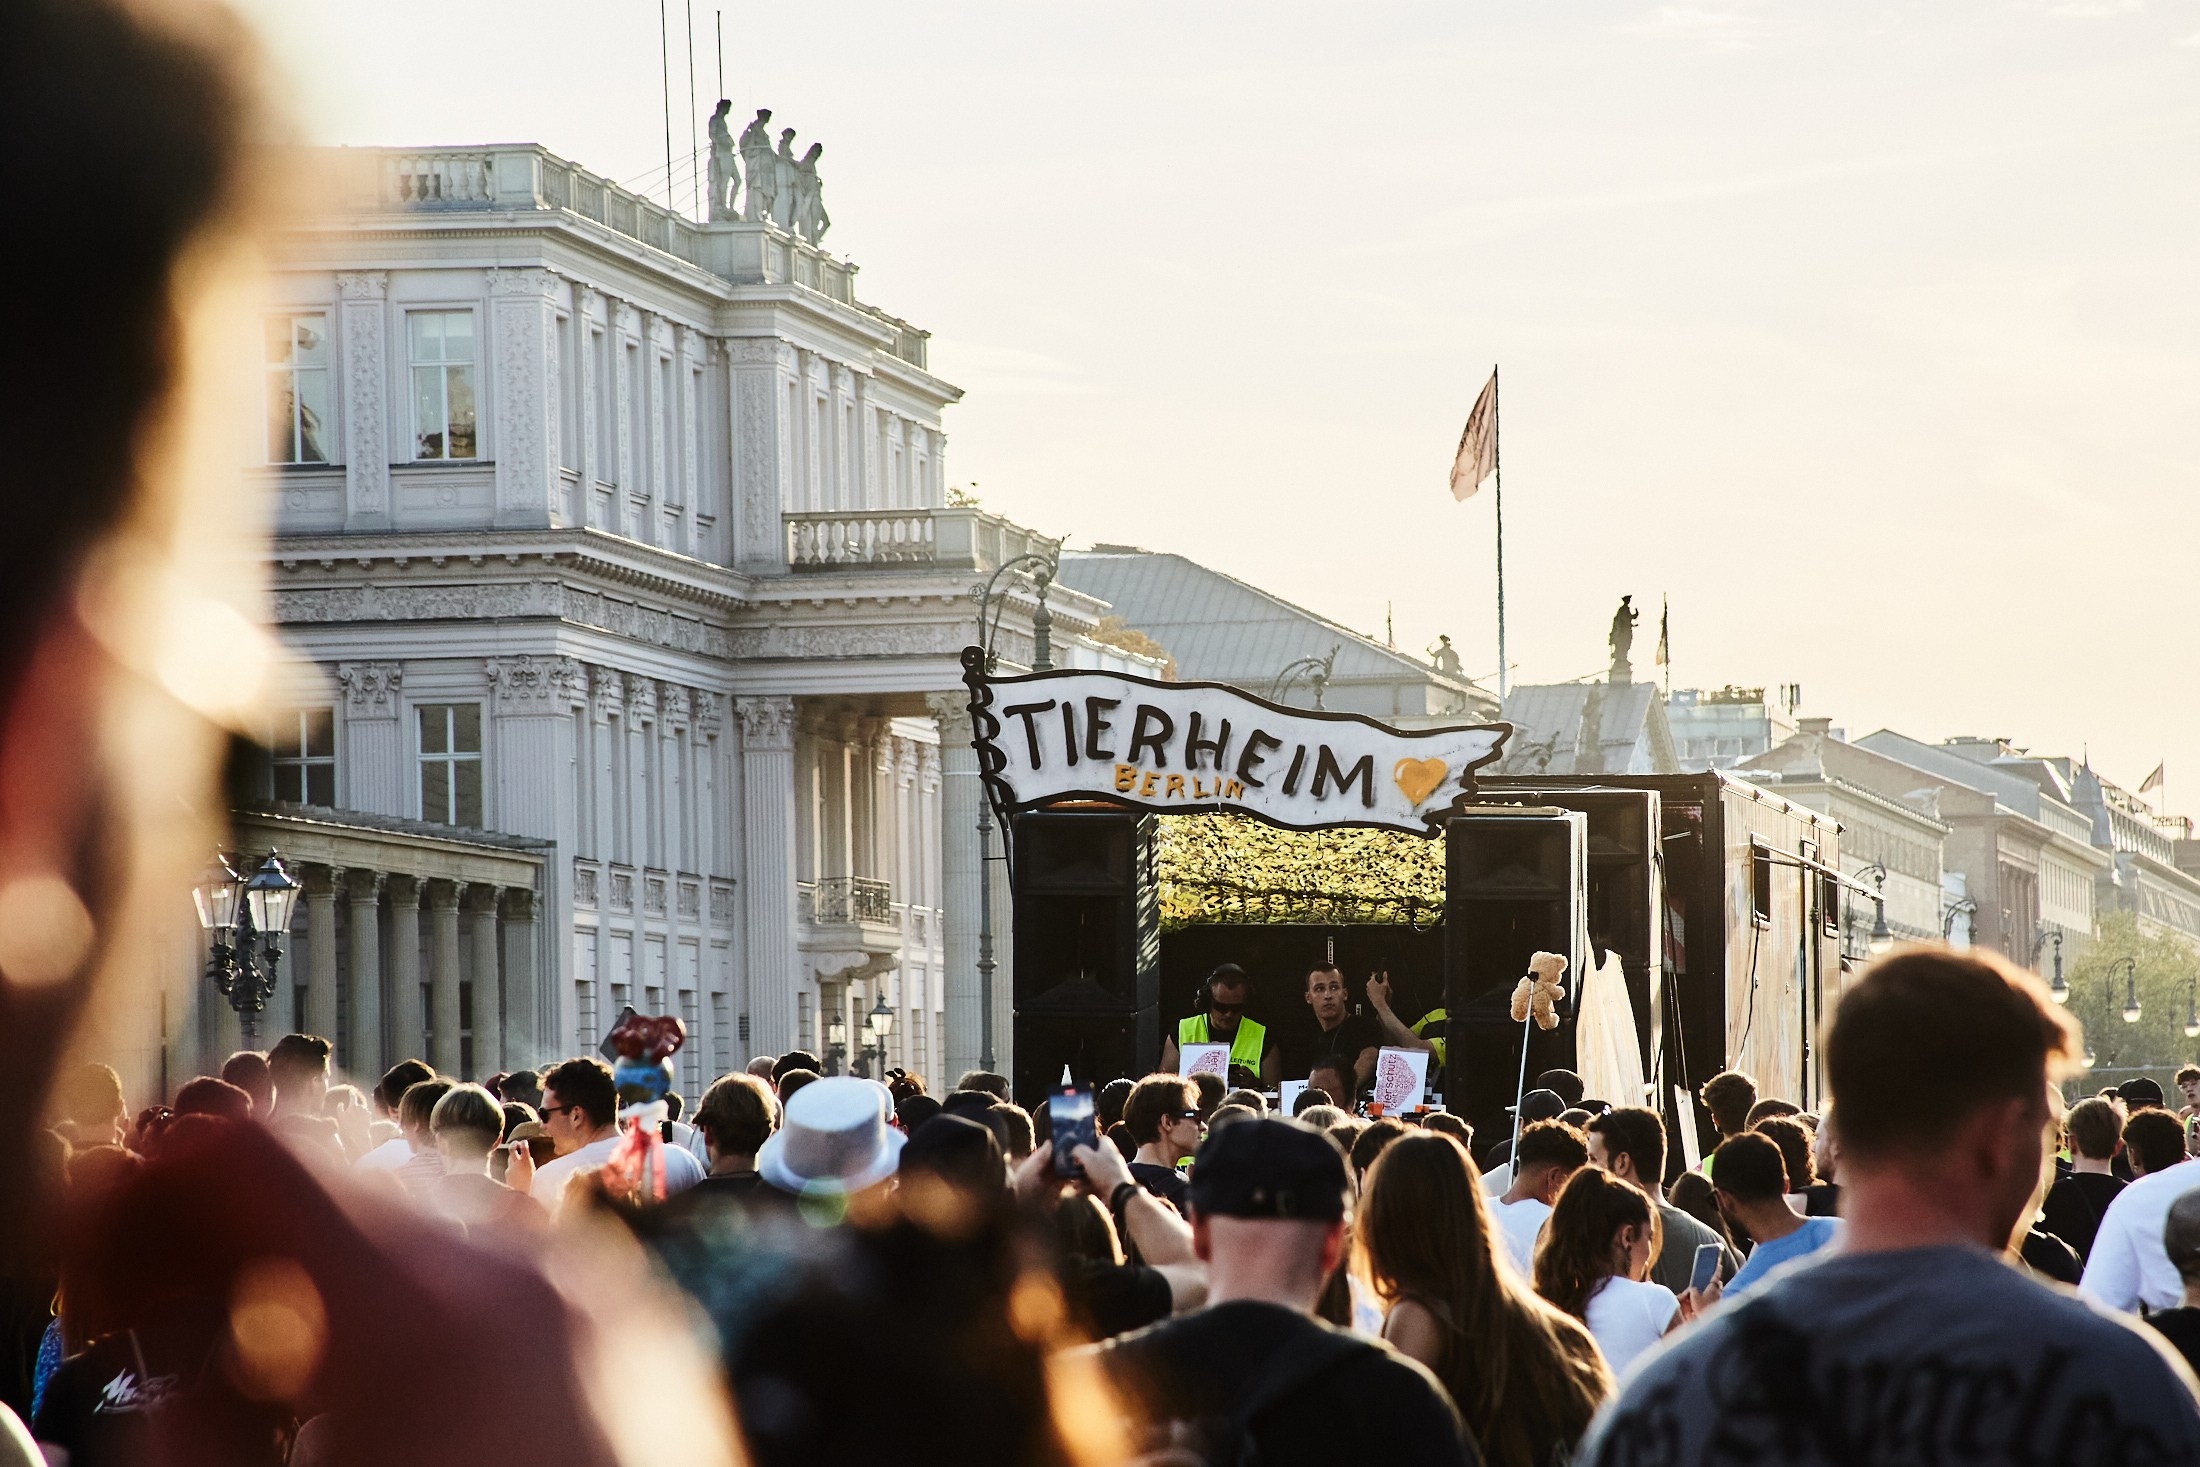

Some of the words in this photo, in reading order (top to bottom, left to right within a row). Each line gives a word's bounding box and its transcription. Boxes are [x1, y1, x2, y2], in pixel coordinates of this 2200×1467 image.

[1003, 697, 1375, 808] TIERHEIM
[1114, 764, 1245, 800] BERLIN
[1383, 1054, 1397, 1109] Tierschutz
